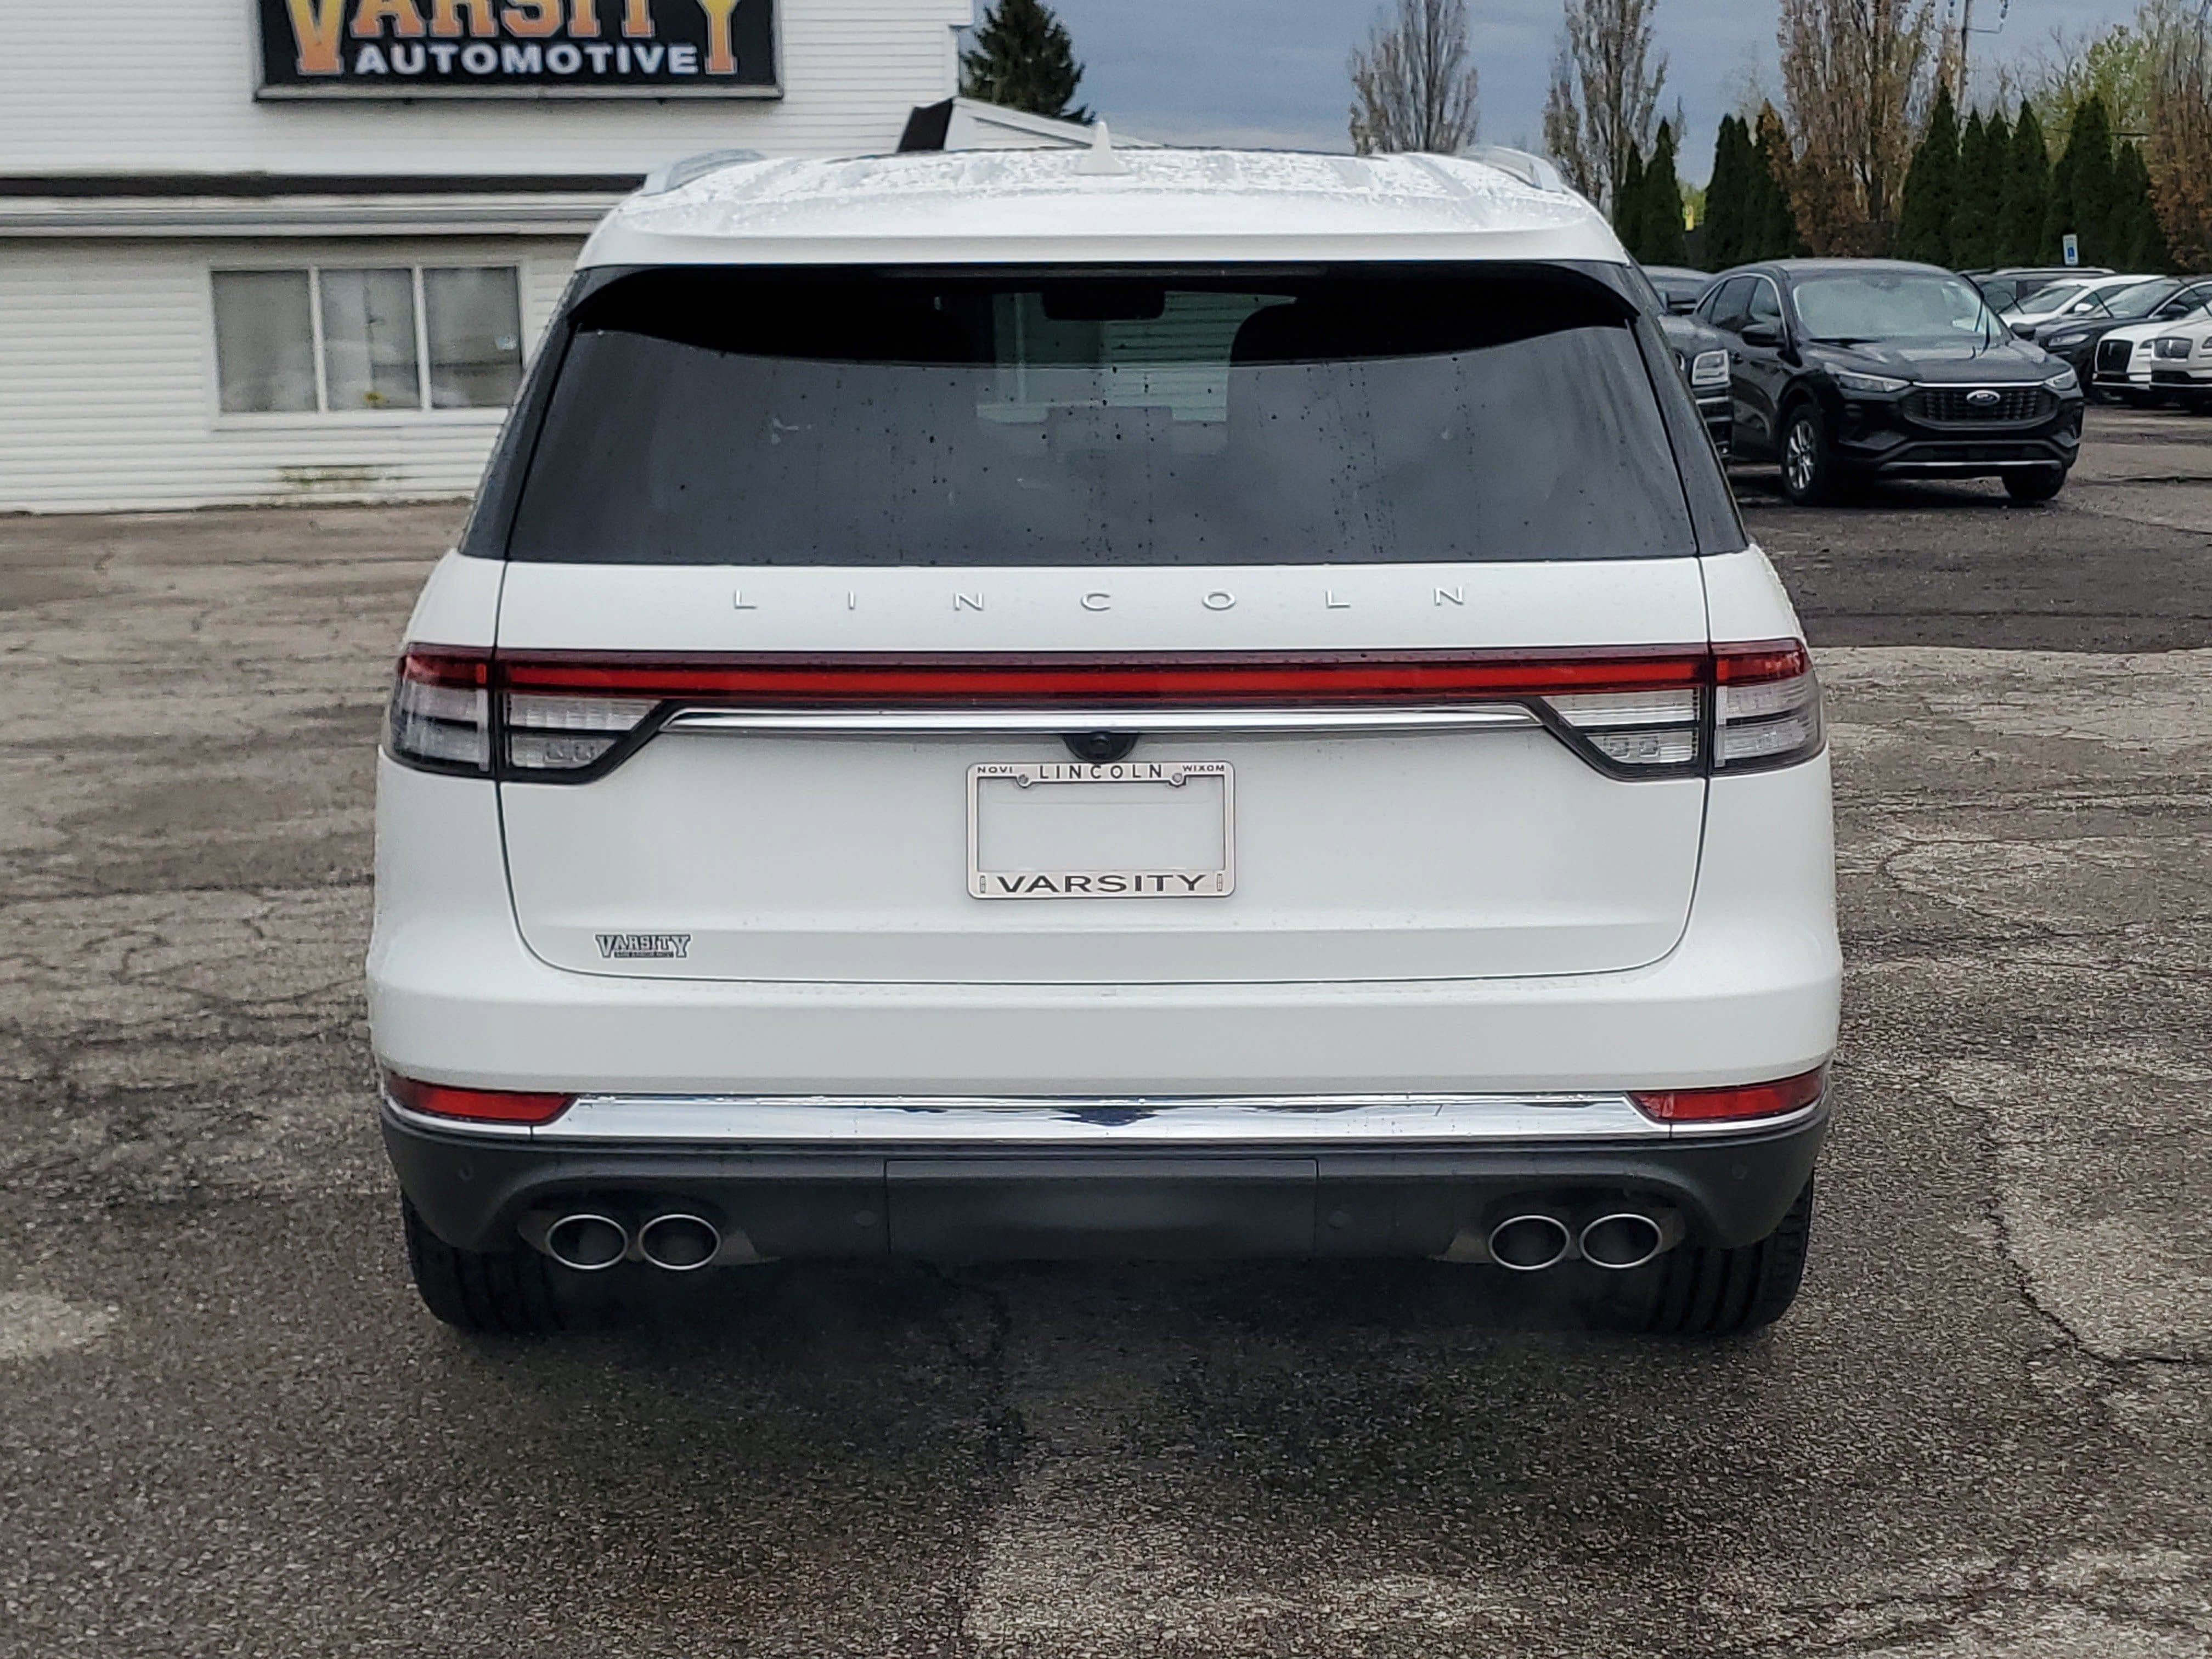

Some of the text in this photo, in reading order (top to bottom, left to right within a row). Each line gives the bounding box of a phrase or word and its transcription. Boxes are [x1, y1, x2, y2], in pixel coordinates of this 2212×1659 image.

[354, 43, 699, 75] AUTOMOTIVE
[733, 586, 1465, 611] LINCOLN
[1039, 764, 1162, 779] LINCOLN
[996, 874, 1206, 893] VARSITY
[595, 934, 691, 958] VARSITY
